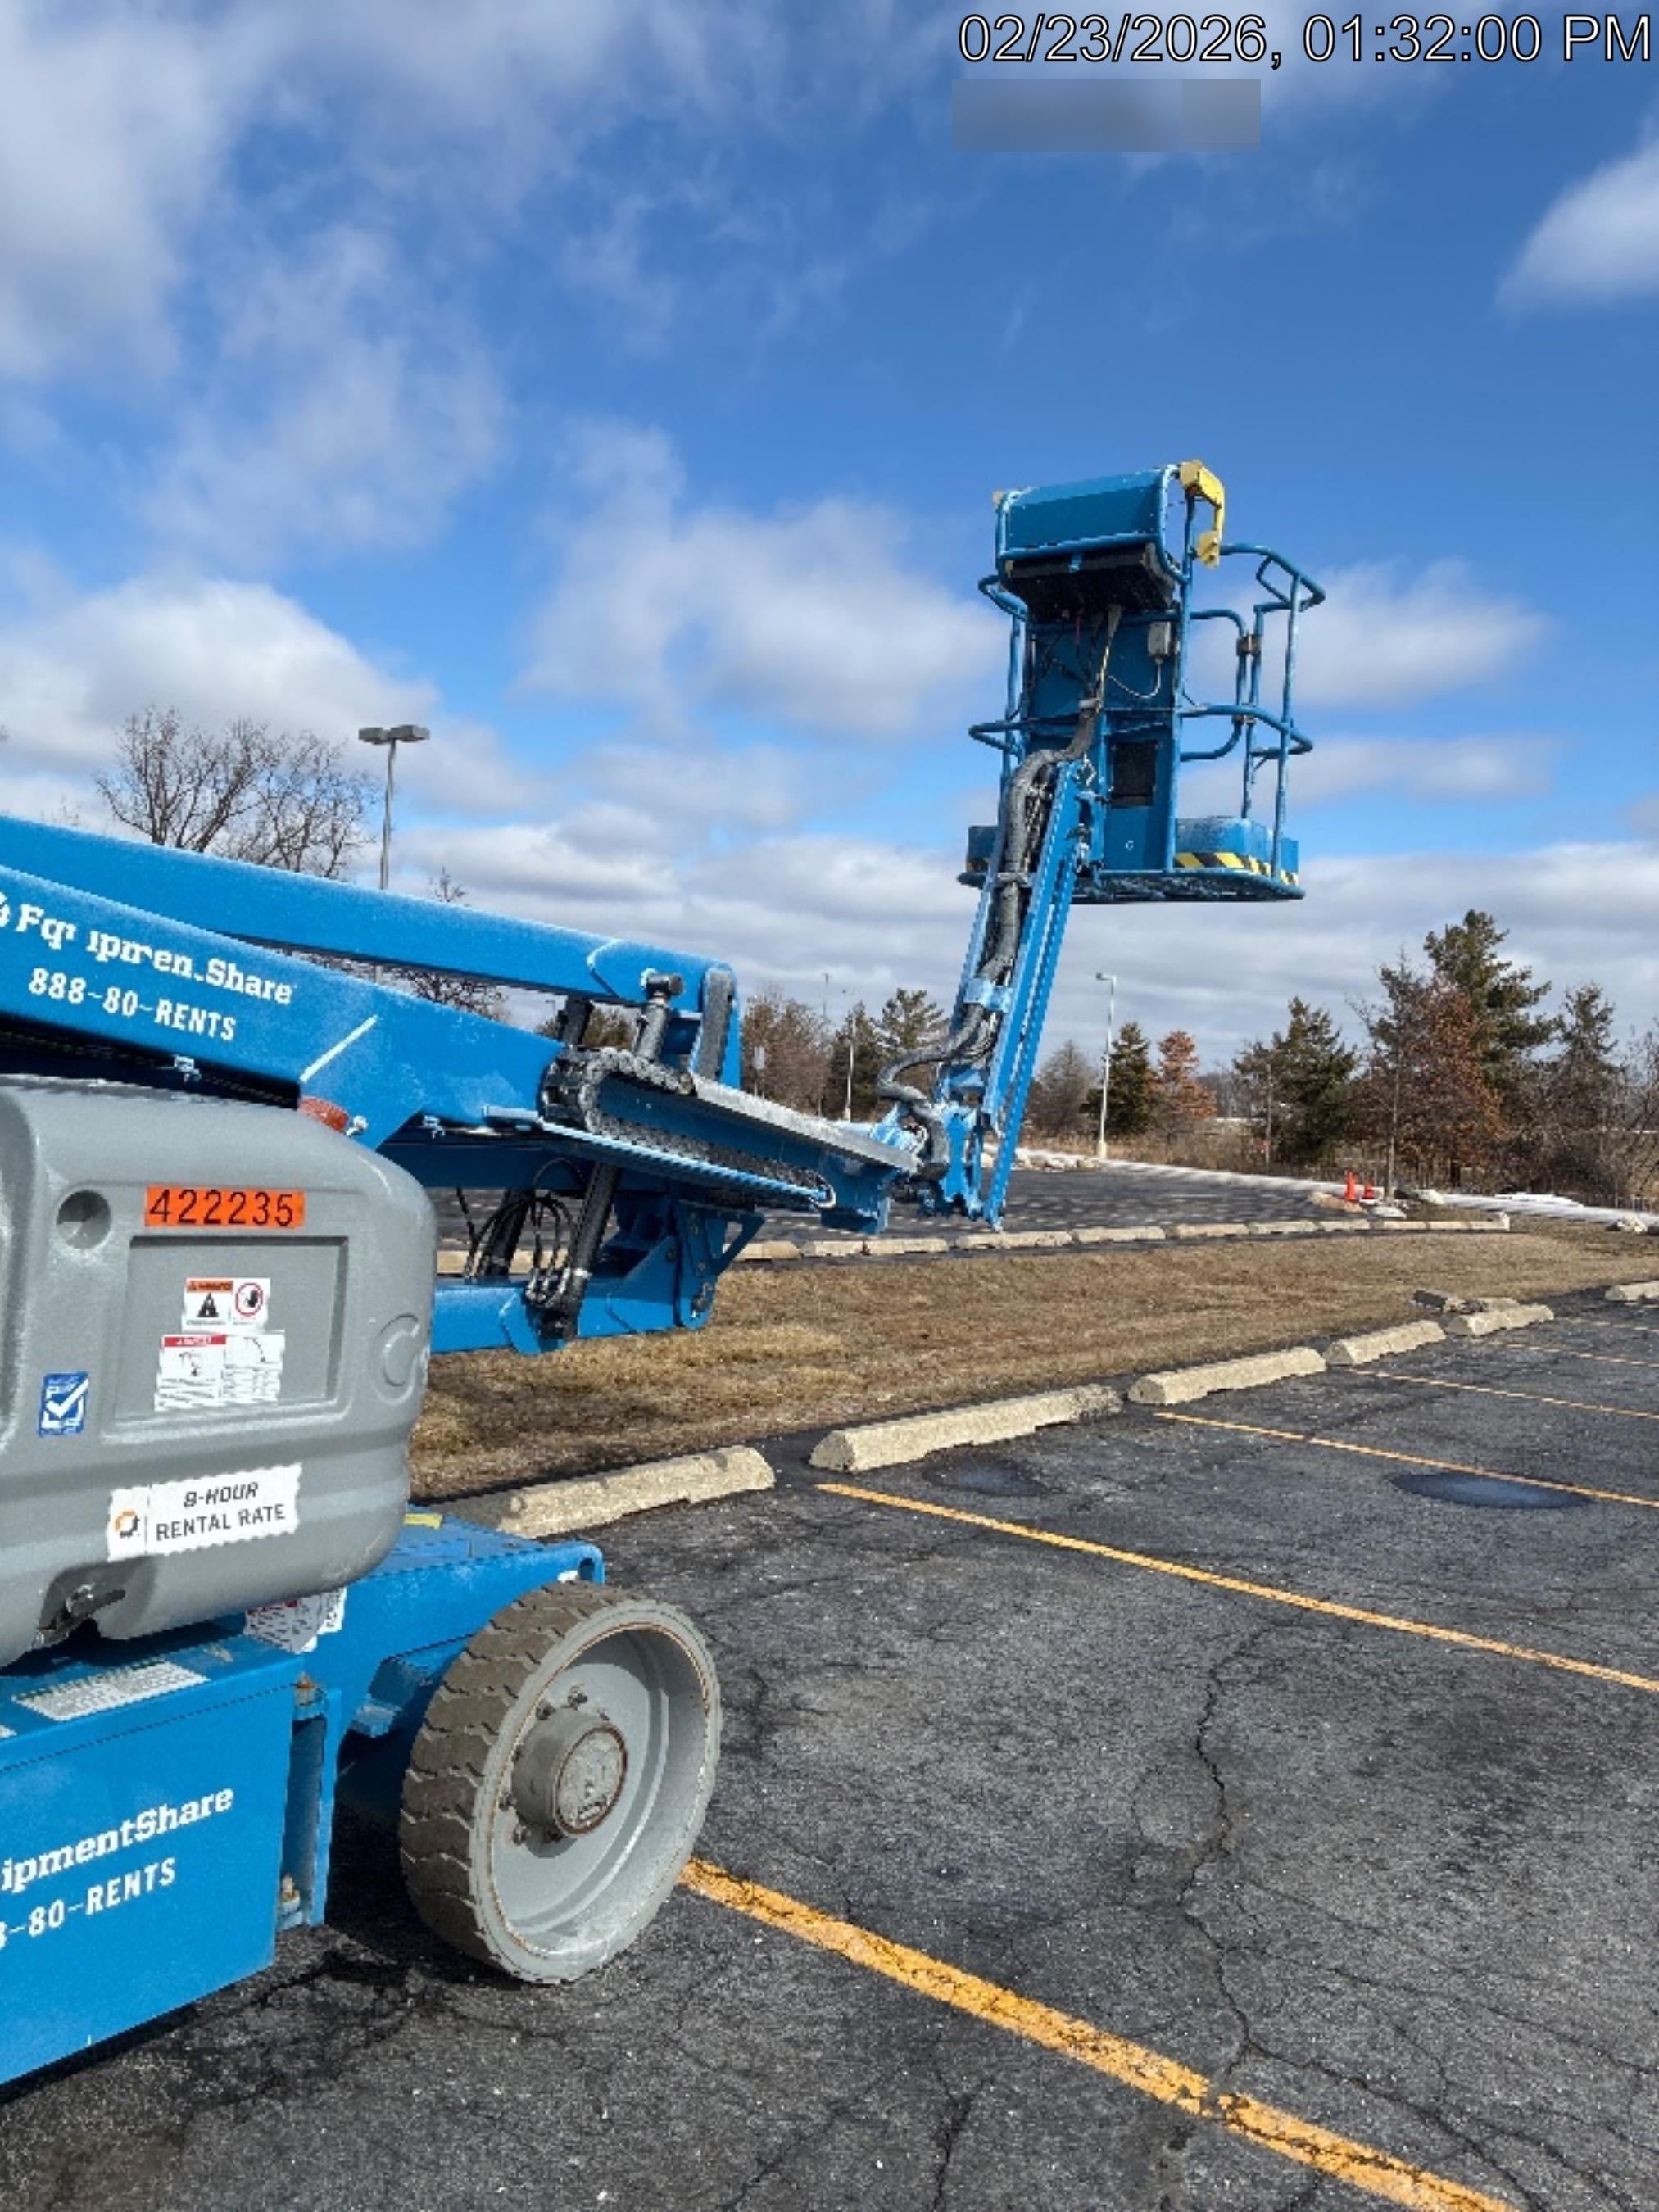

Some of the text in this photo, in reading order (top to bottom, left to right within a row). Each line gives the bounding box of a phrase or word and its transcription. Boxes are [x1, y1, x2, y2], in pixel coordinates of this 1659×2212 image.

[29, 968, 237, 1041] 888-80-RENTS
[149, 1189, 293, 1226] 422235
[184, 1481, 258, 1507] 8-HOUR
[156, 1503, 287, 1541] RENTAL RATE
[1, 1788, 234, 1894] ipmentShare
